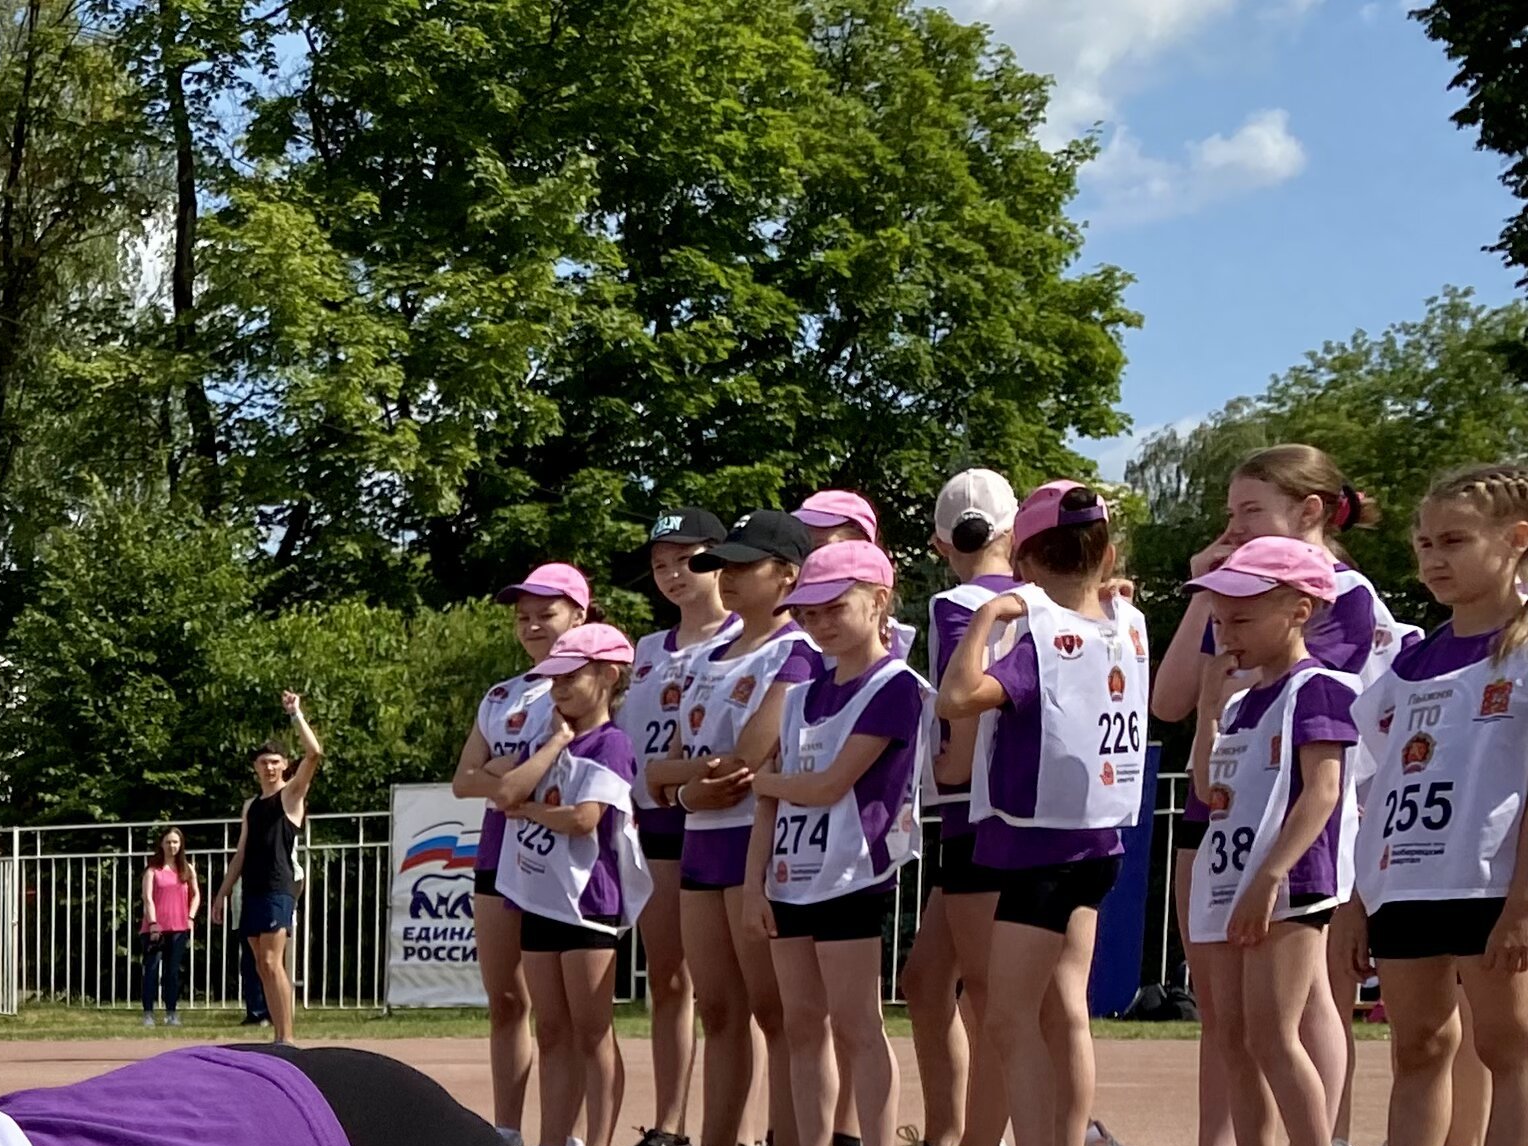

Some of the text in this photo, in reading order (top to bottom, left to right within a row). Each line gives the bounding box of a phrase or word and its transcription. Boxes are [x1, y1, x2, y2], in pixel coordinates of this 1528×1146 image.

[644, 718, 677, 754] 22
[1098, 710, 1140, 755] 226
[1383, 781, 1454, 839] 255
[774, 813, 830, 855] 274
[402, 926, 476, 943] ЕДИНА
[402, 946, 478, 962] РОССИ
